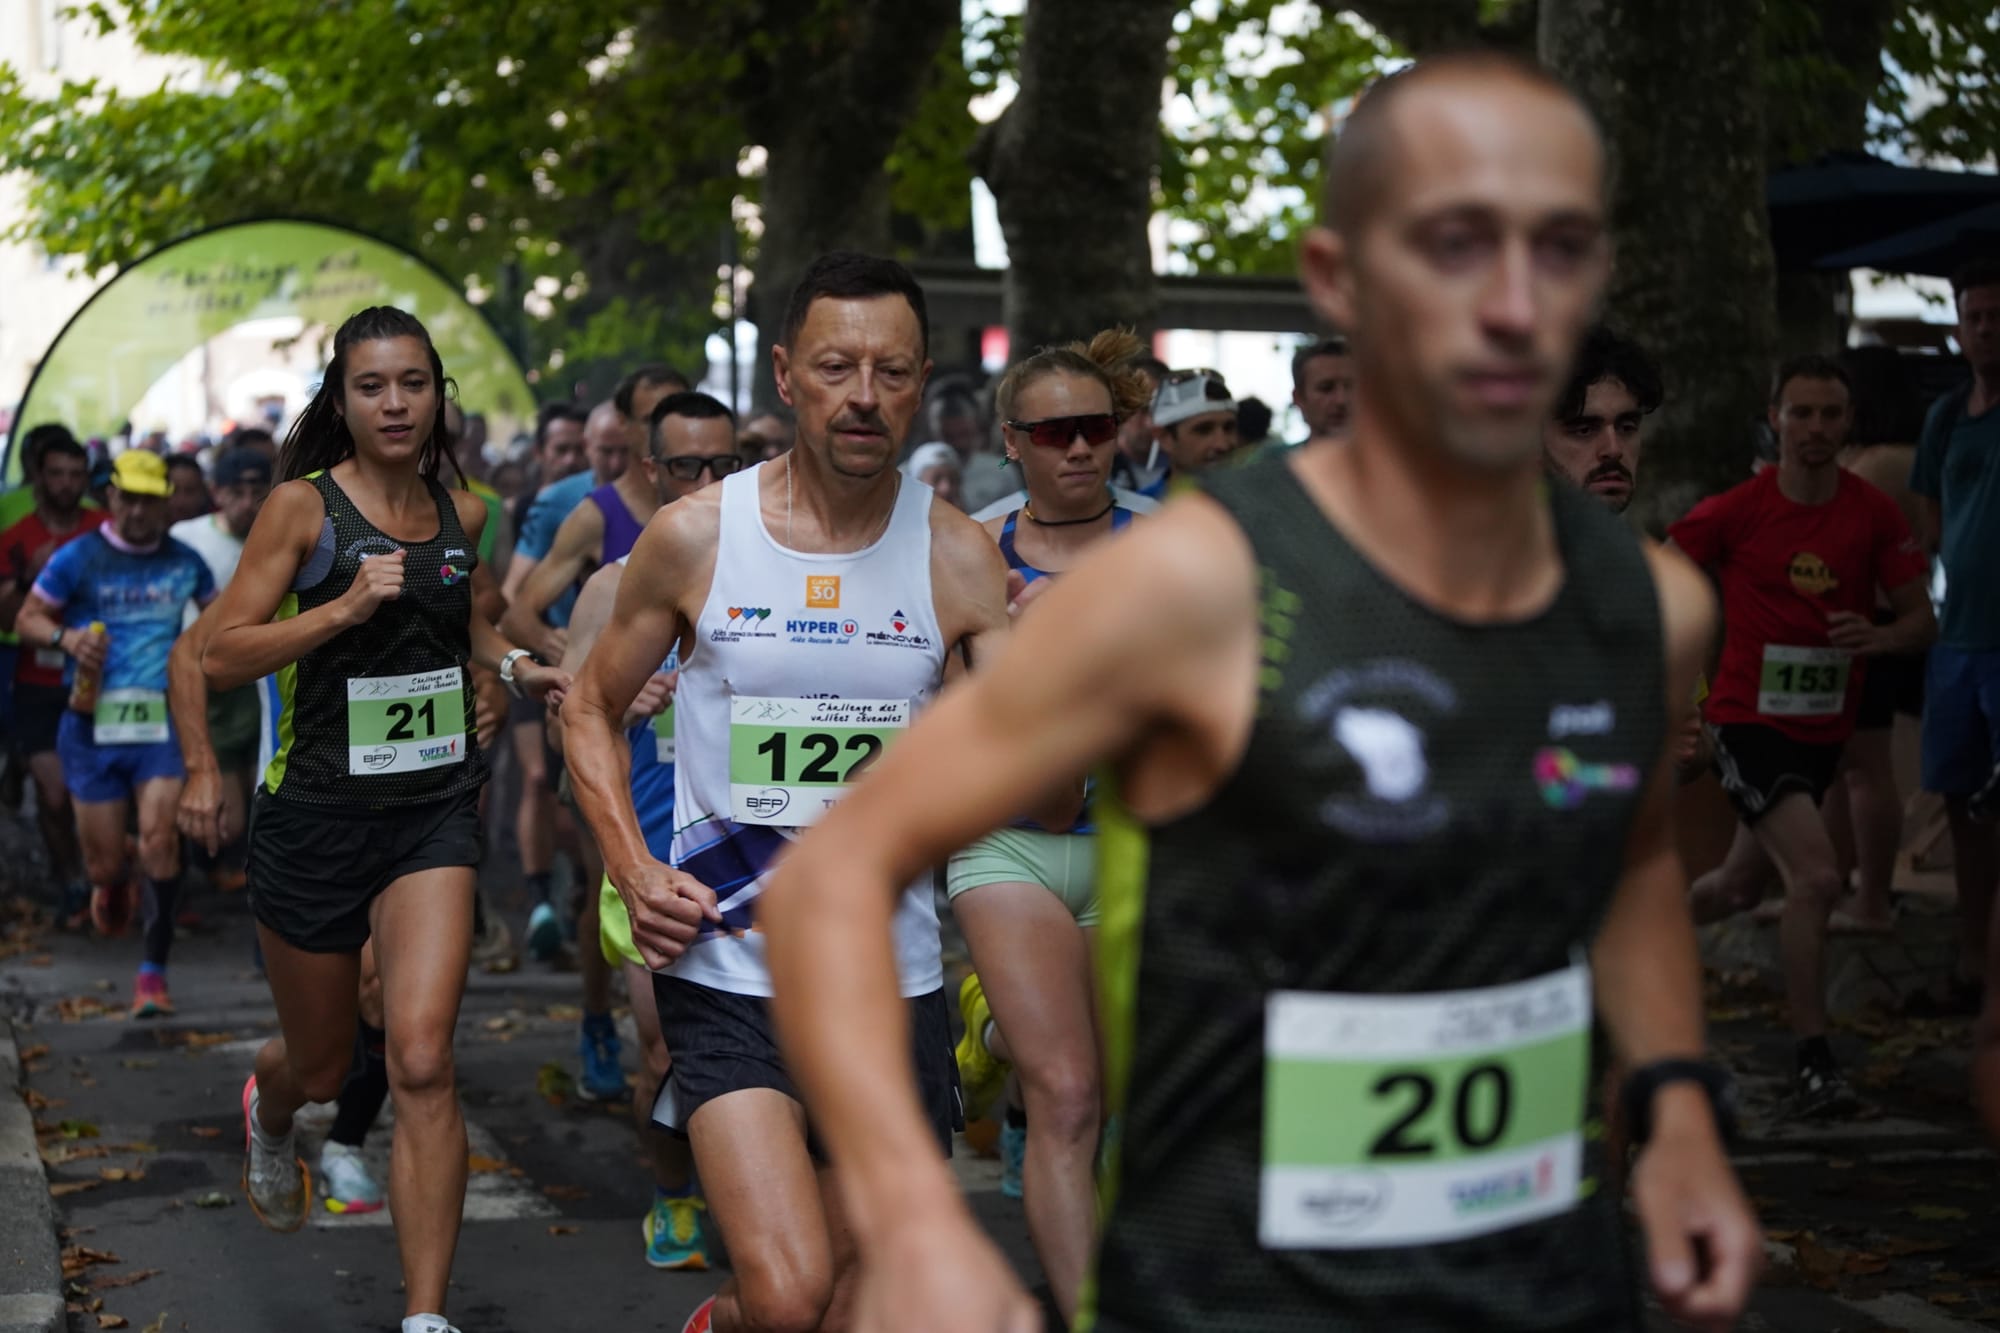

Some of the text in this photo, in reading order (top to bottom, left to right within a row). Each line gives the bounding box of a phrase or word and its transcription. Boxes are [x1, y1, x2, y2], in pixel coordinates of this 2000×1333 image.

[811, 585, 835, 600] 30
[786, 620, 838, 634] HYPER
[1776, 664, 1838, 693] 153
[114, 702, 149, 723] 75
[817, 702, 897, 716] Challenge des
[385, 697, 435, 741] 21
[810, 713, 903, 723] vallées cévenoles
[363, 753, 392, 763] BFP
[758, 732, 883, 782] 122
[746, 796, 783, 808] BFP
[1367, 1059, 1513, 1158] 20
